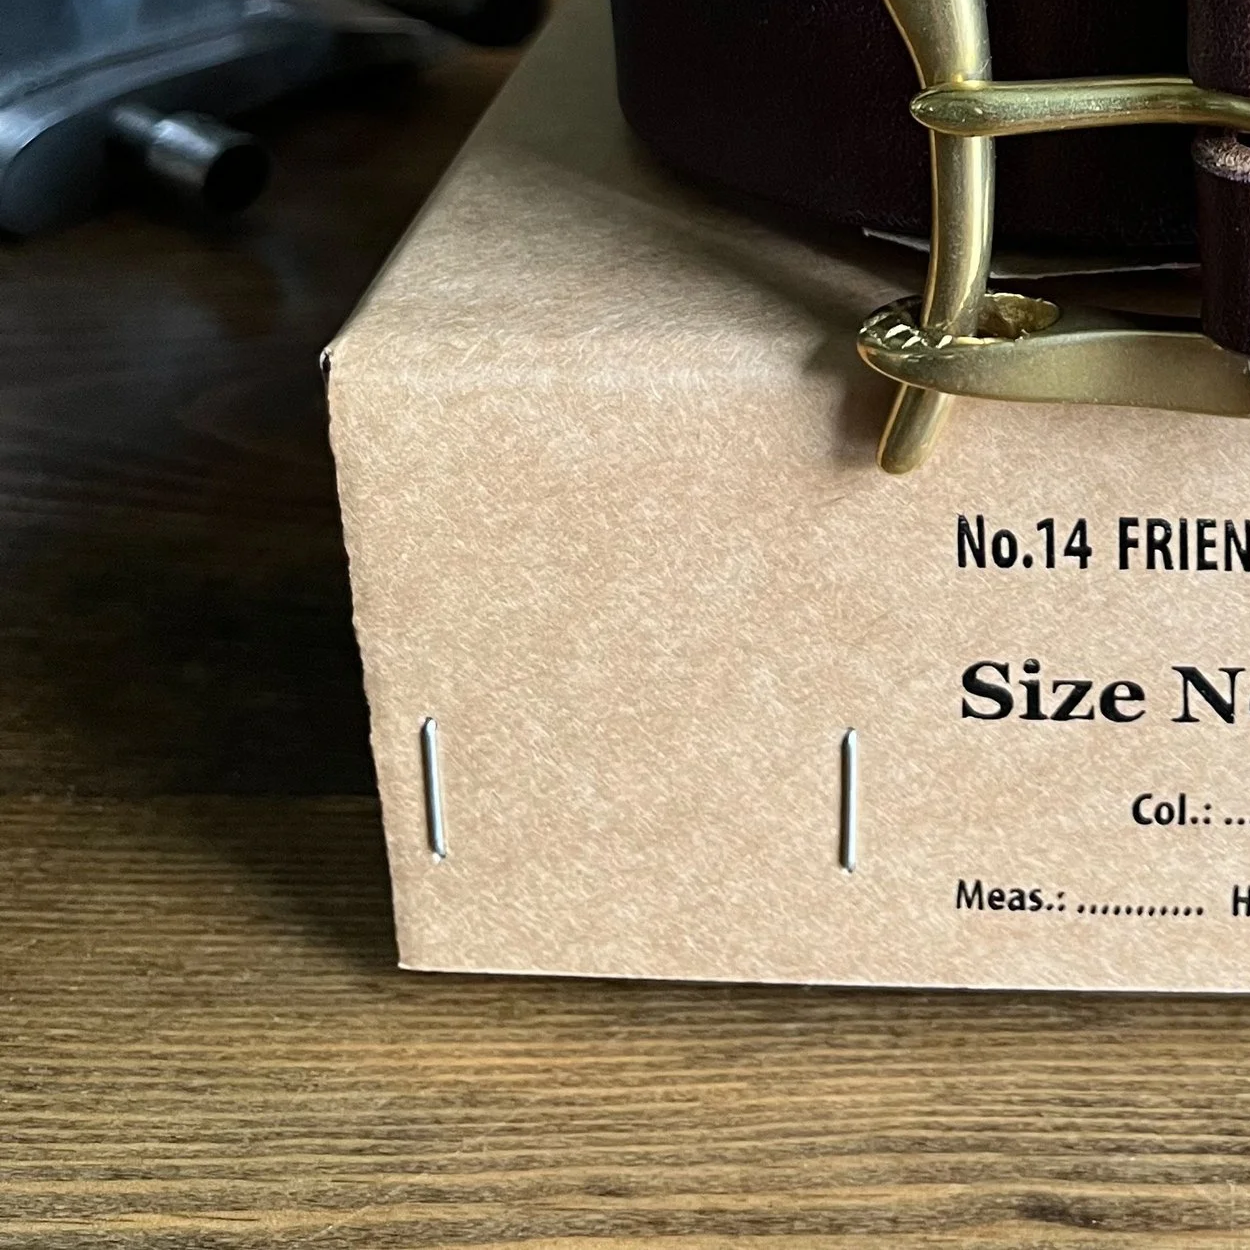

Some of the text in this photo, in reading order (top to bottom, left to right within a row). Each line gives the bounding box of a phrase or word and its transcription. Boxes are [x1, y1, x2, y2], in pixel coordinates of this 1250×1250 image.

[956, 513, 1094, 571] No.14
[960, 657, 1147, 724] Size
[1131, 792, 1213, 827] Col.:
[955, 878, 1066, 913] Meas.:
